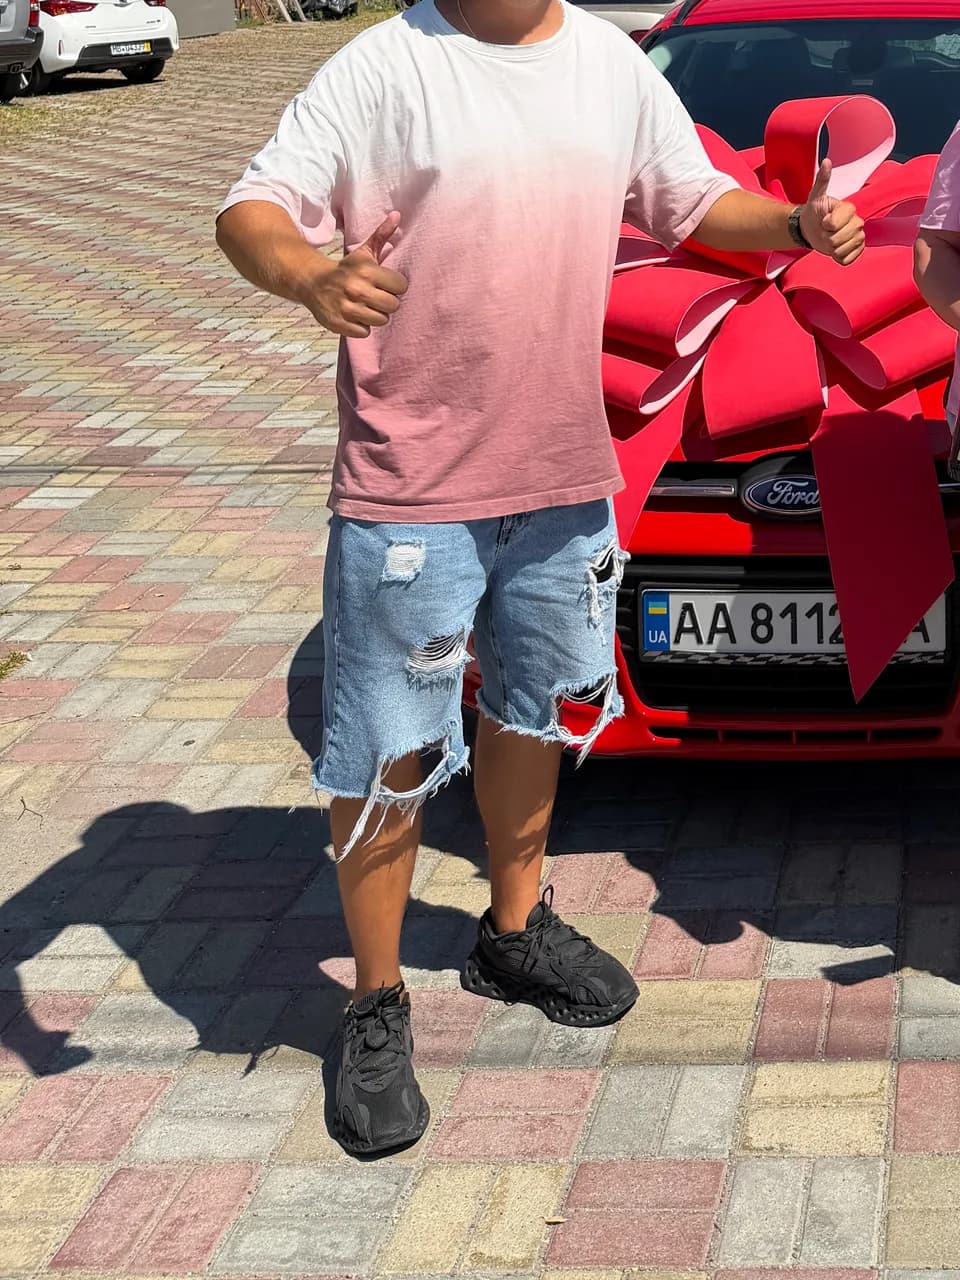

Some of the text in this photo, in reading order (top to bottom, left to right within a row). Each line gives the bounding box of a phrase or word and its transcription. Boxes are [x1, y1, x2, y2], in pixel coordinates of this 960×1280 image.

[766, 480, 820, 505] Ford
[673, 601, 737, 645] AA
[648, 630, 668, 644] UA
